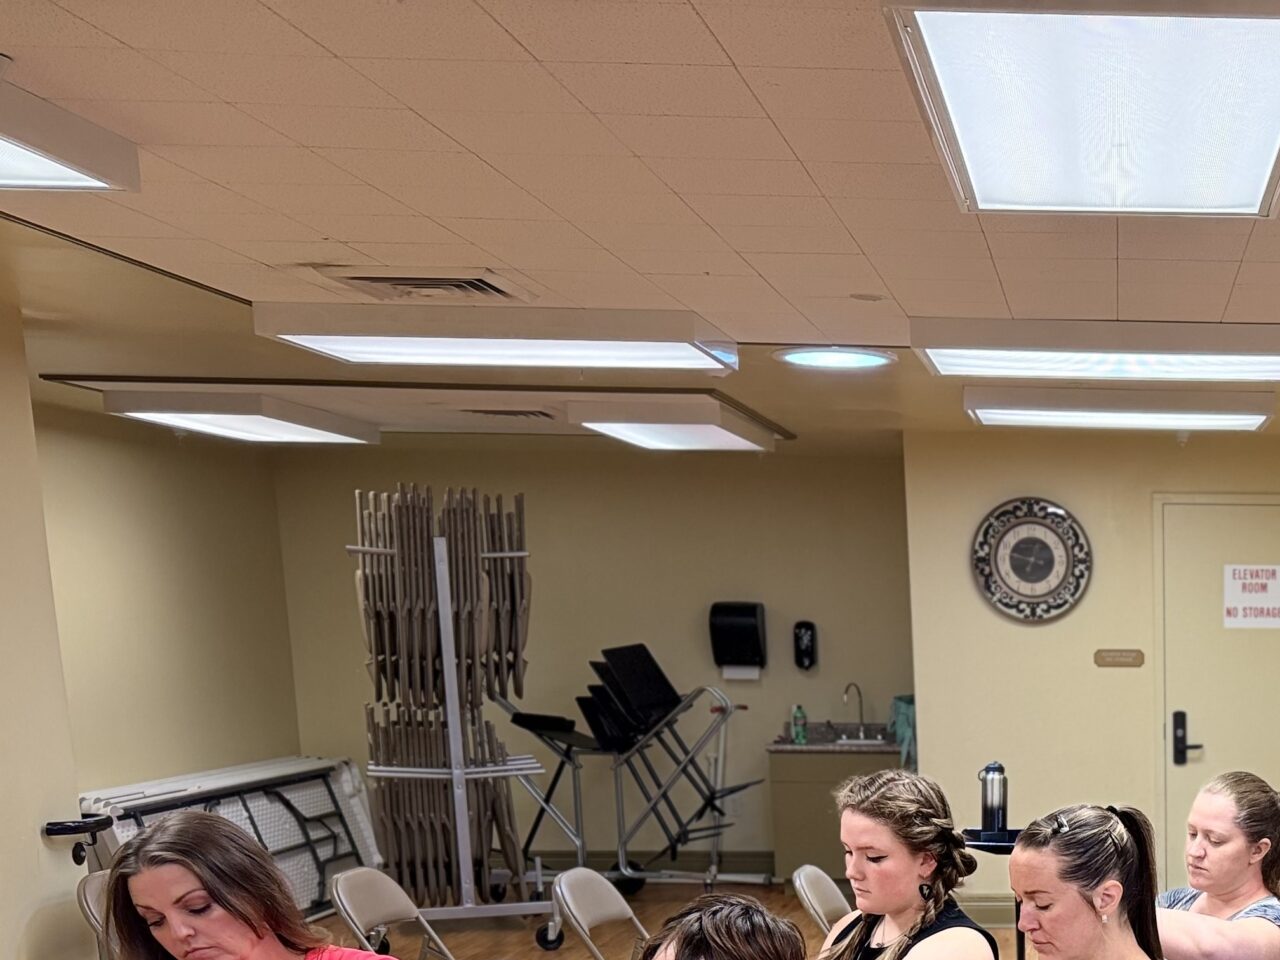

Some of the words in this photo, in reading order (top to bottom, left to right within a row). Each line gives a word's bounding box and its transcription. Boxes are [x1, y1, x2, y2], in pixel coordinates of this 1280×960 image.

[1232, 568, 1277, 580] ELEVATOR
[1242, 582, 1268, 594] ROOM
[1226, 606, 1239, 618] NO
